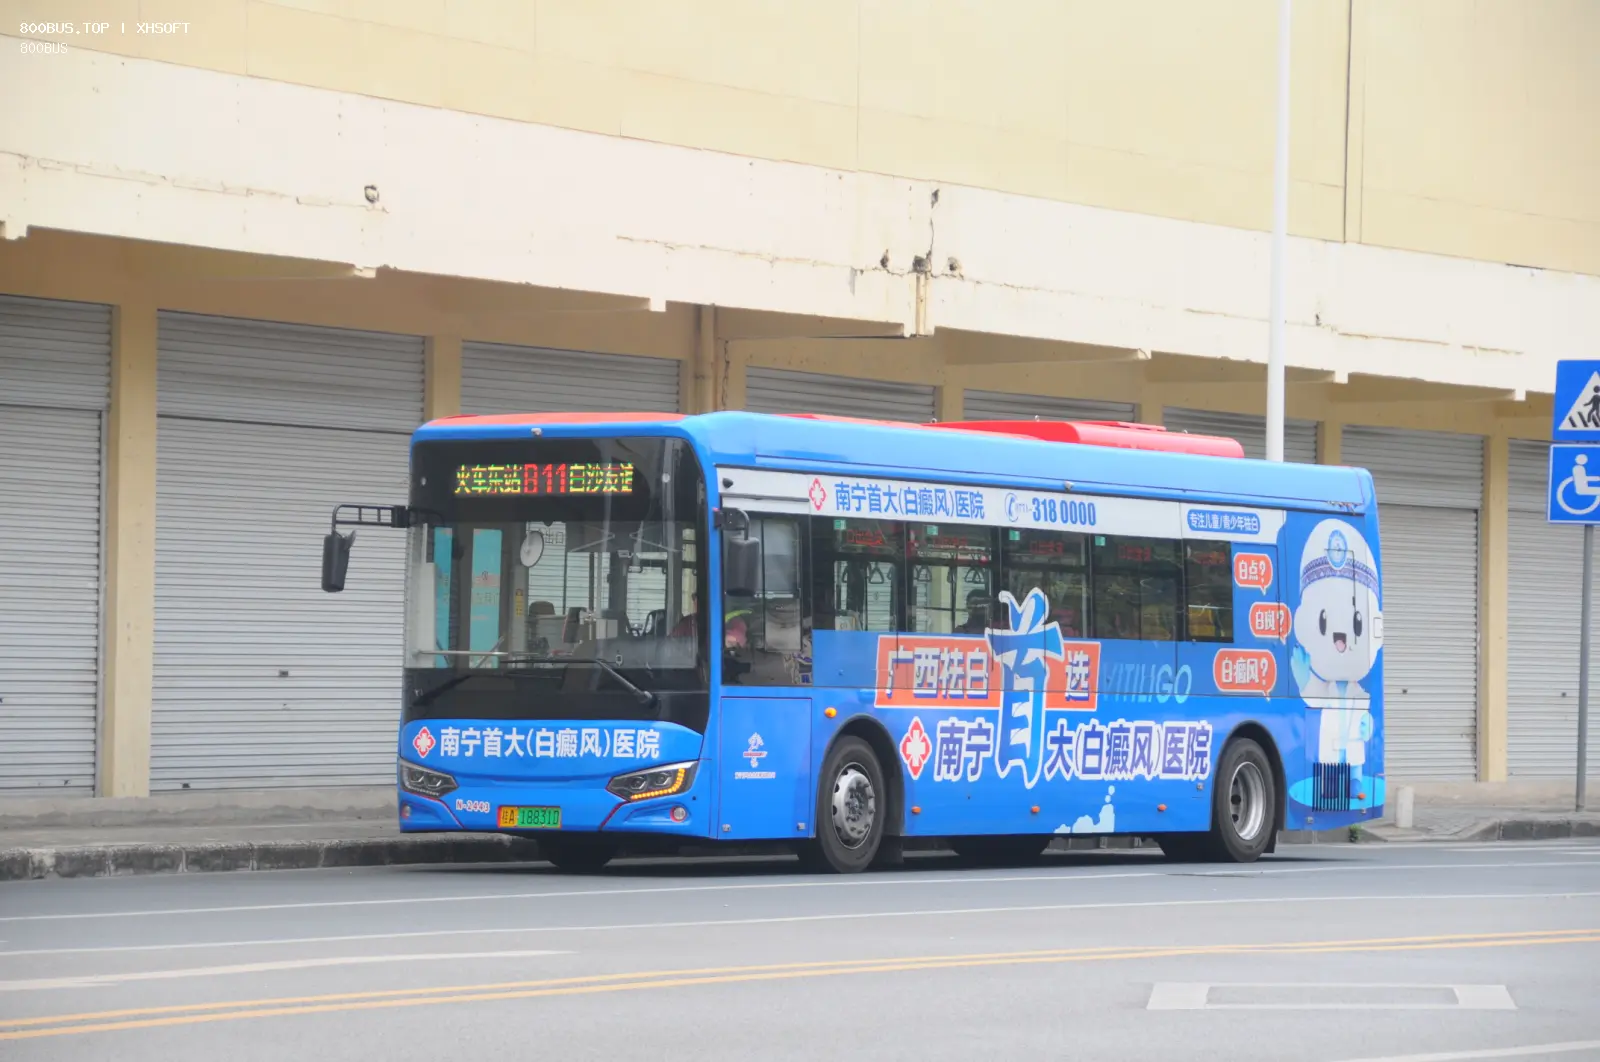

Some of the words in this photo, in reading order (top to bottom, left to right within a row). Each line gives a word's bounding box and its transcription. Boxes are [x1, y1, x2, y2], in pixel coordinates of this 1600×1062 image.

[454, 463, 521, 494] 火车东站
[1102, 663, 1193, 704] VITILIGO
